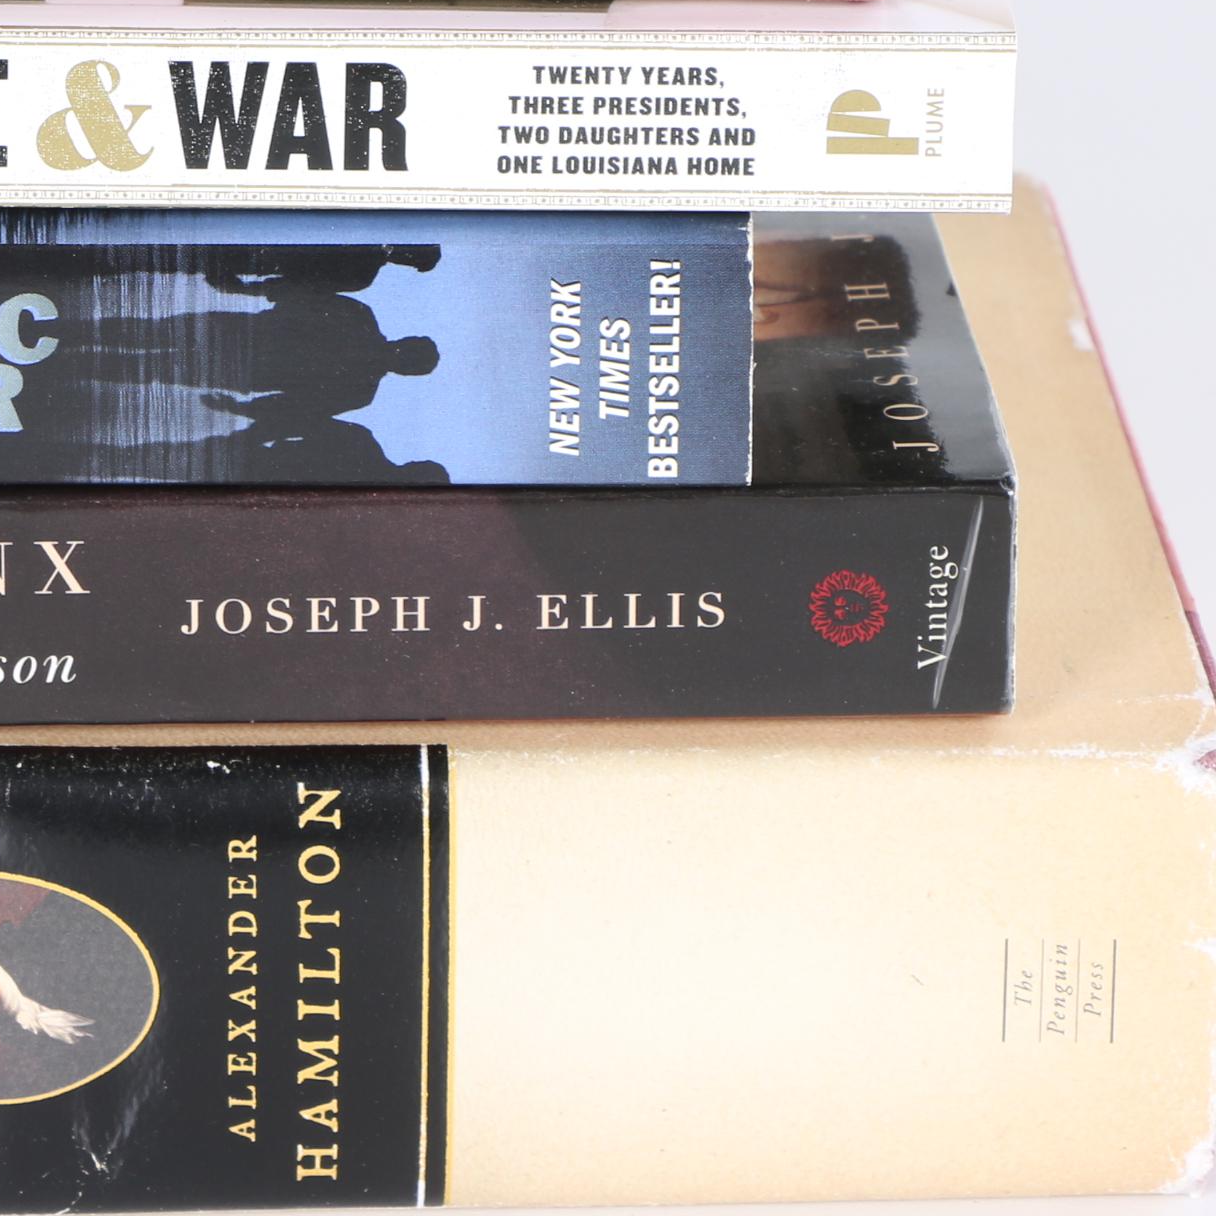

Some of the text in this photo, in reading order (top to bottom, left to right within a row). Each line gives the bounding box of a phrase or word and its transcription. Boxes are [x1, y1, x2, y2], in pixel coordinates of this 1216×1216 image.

[35, 59, 155, 173] &
[167, 60, 409, 172] WAR
[508, 95, 747, 119] THREE PRESIDENTS,
[532, 65, 724, 88] TWENTY YEARS,
[925, 88, 944, 157] PLUME
[496, 155, 755, 176] ONE LOUISIANA HOME
[497, 125, 756, 147] TWO DAUGHTERS AND
[546, 277, 584, 460] NEW YORK
[598, 314, 634, 424] TIMES
[646, 258, 683, 480] BESTSELLER!
[844, 282, 941, 452] JOSEPH
[180, 591, 725, 635] JOSEPH J. ELLIS
[917, 545, 950, 671] Vintage
[227, 834, 258, 1143] ALEXANDER
[296, 781, 342, 1182] HAMILTON
[1014, 969, 1034, 1006] The
[1046, 942, 1073, 1036] Penguin
[1083, 961, 1105, 1017] Press
